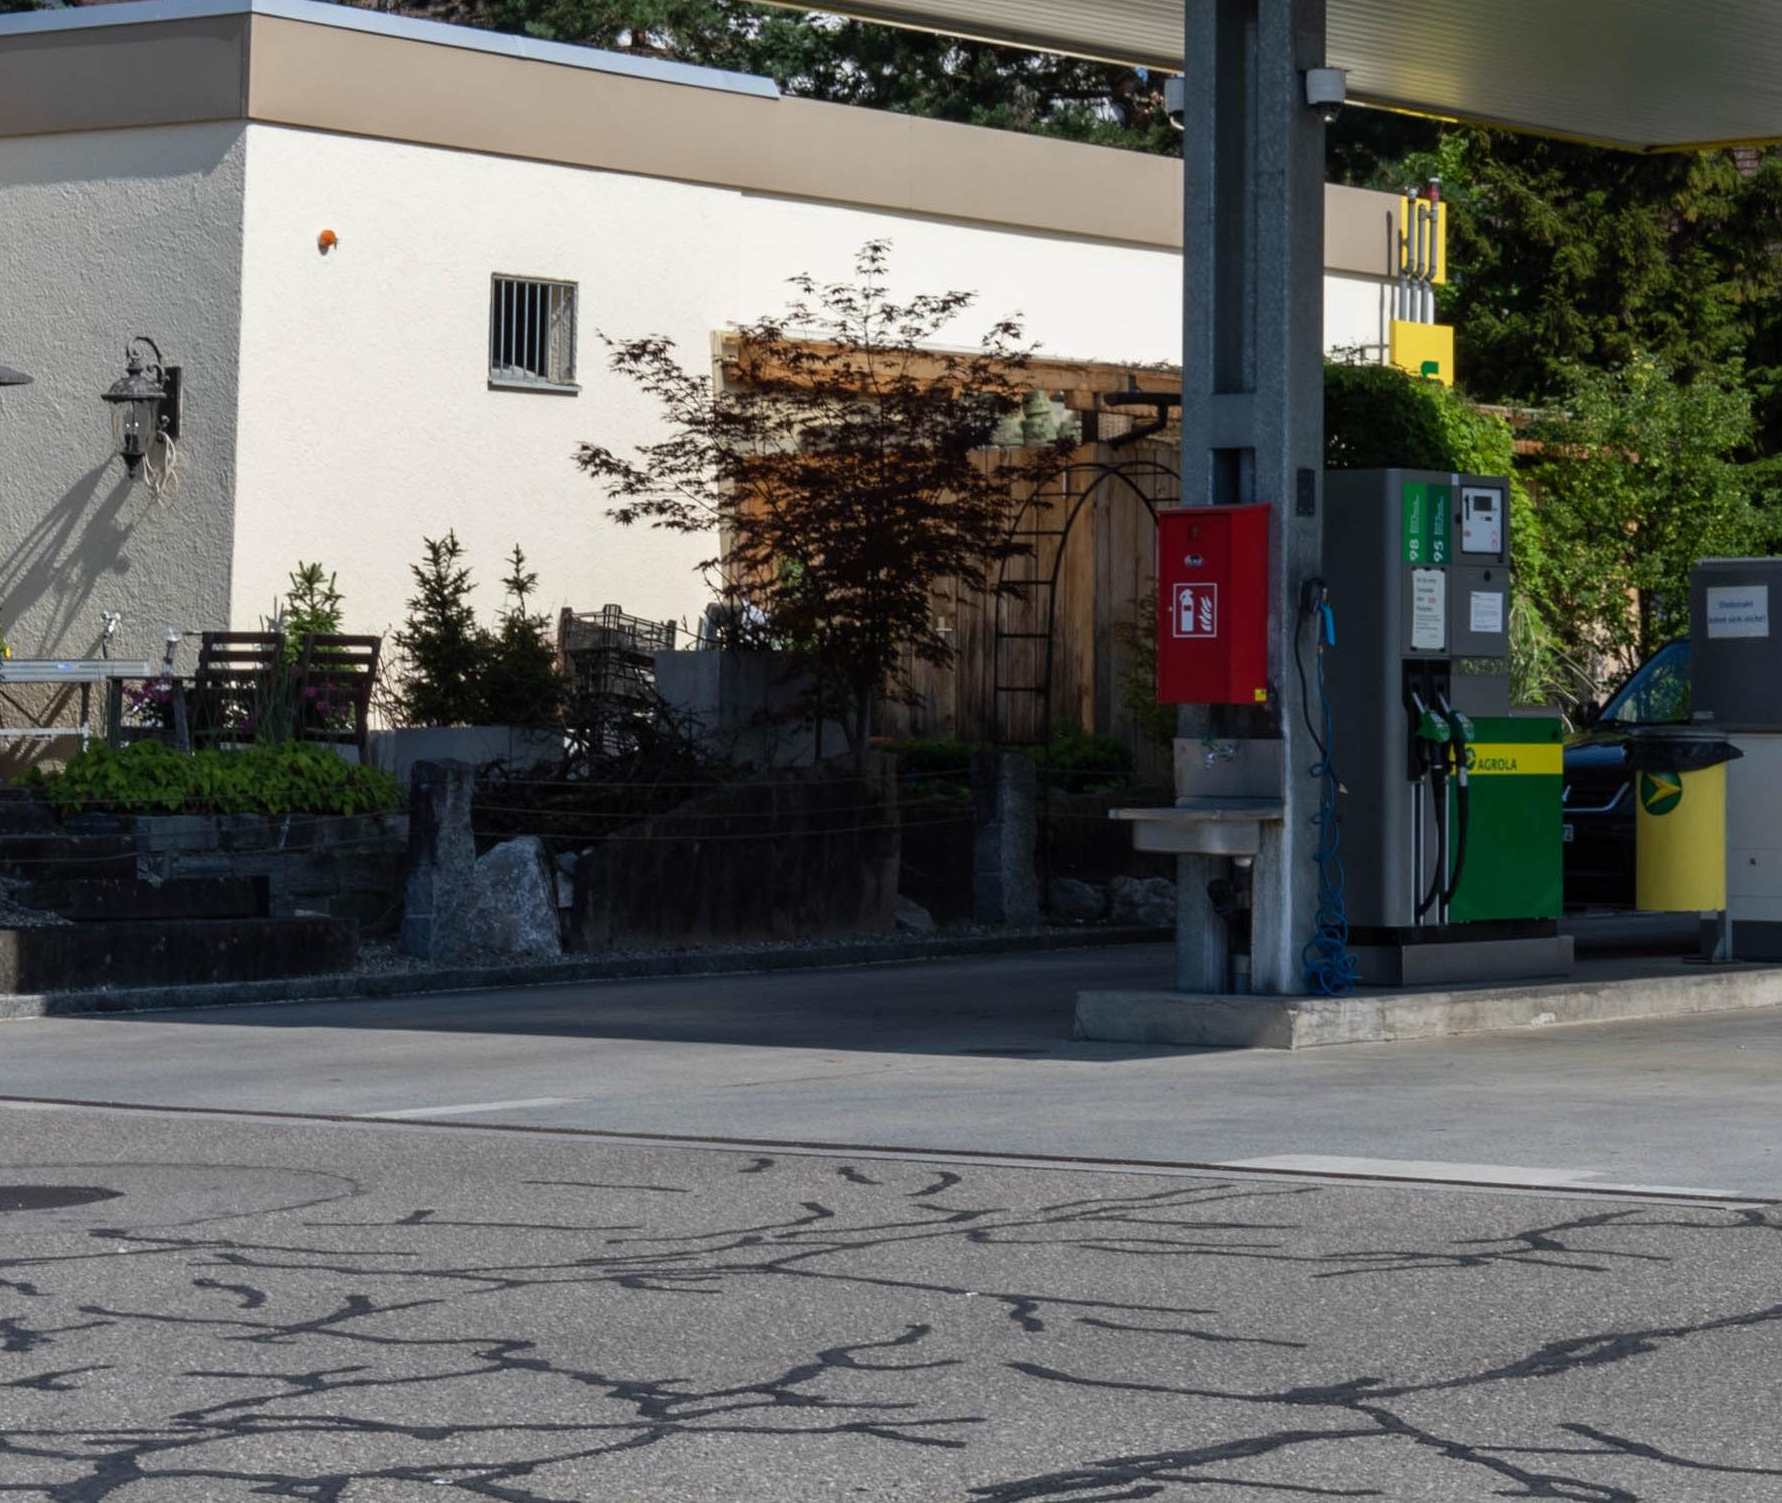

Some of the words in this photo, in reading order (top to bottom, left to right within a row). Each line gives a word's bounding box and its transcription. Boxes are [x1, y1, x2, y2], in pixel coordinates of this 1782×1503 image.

[1409, 538, 1421, 562] 98
[1432, 539, 1444, 563] 95
[1477, 758, 1518, 771] AGROLA
